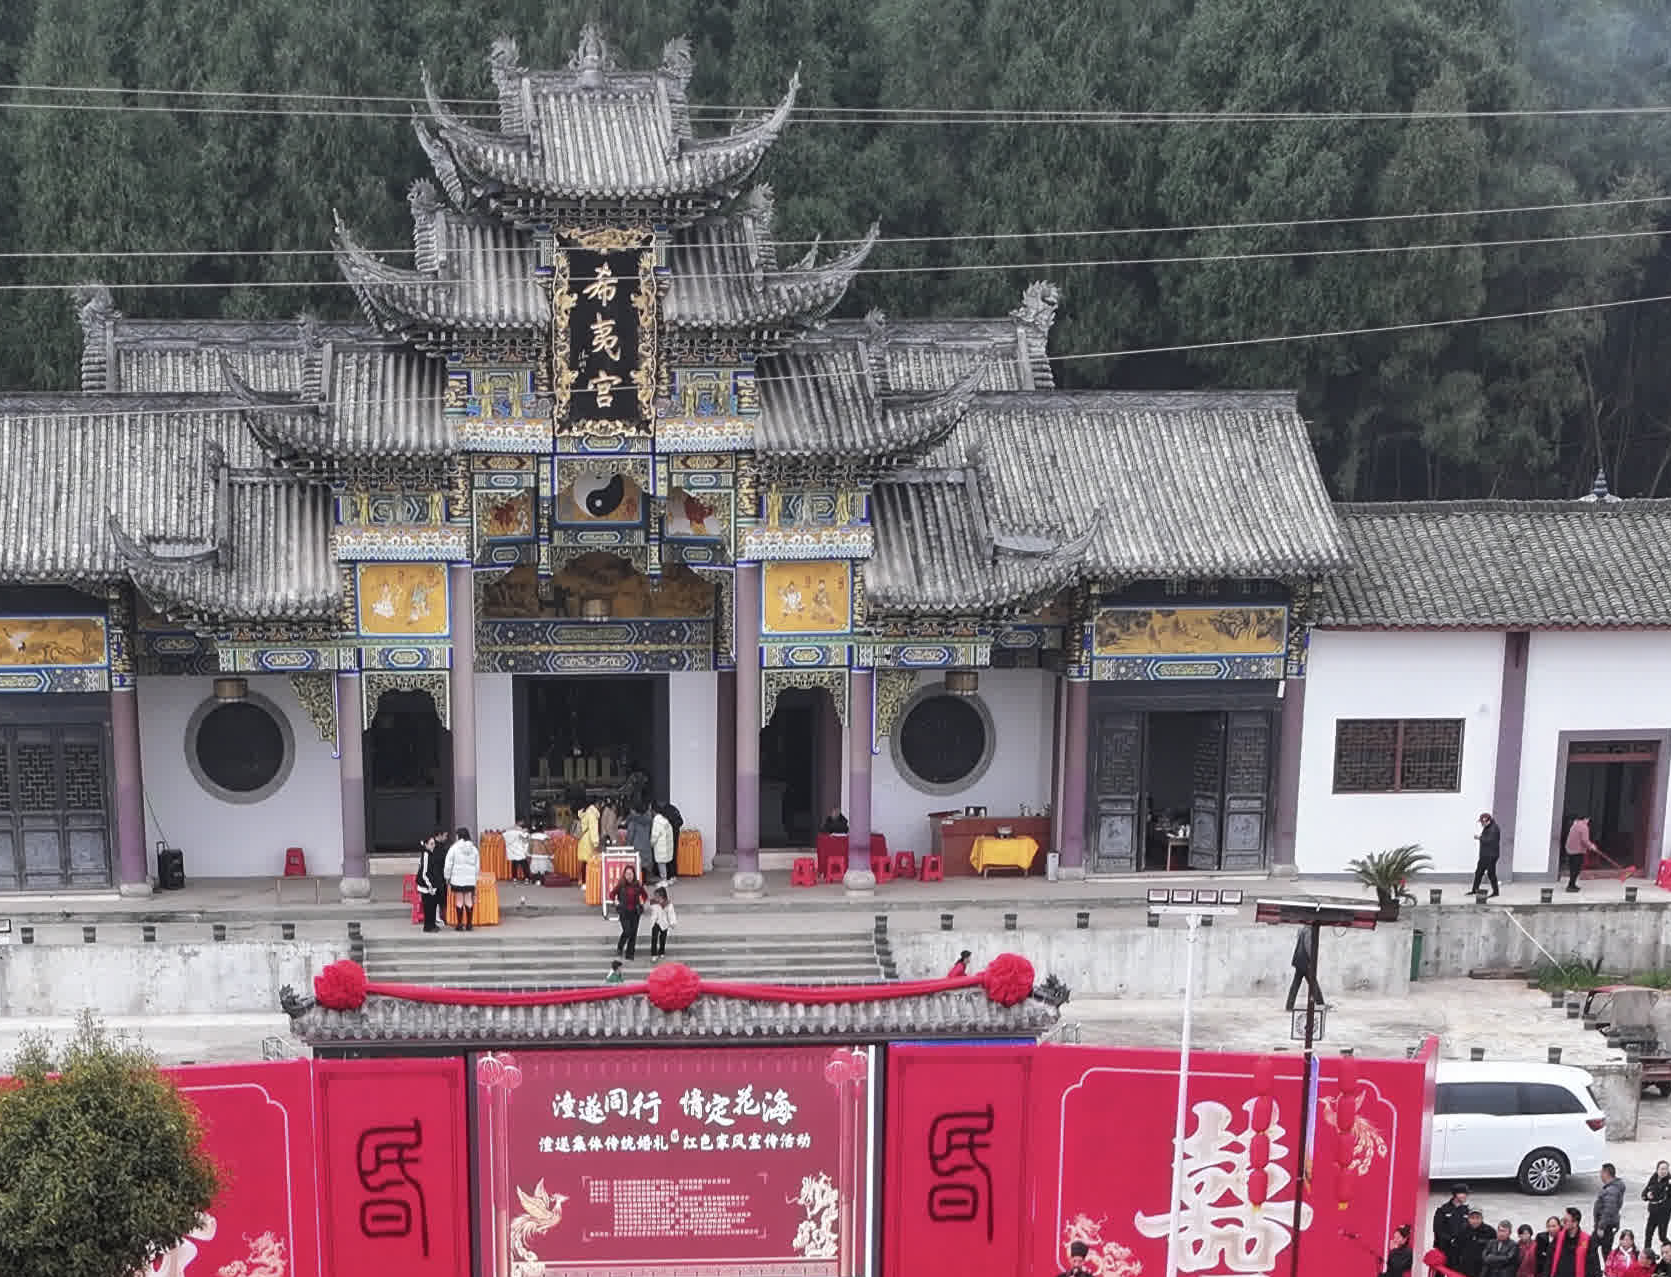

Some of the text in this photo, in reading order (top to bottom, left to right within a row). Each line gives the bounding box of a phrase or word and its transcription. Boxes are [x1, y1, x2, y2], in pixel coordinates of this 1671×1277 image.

[583, 262, 624, 408] 希夷宫
[552, 1084, 798, 1127] 潼遂同行 情定花海
